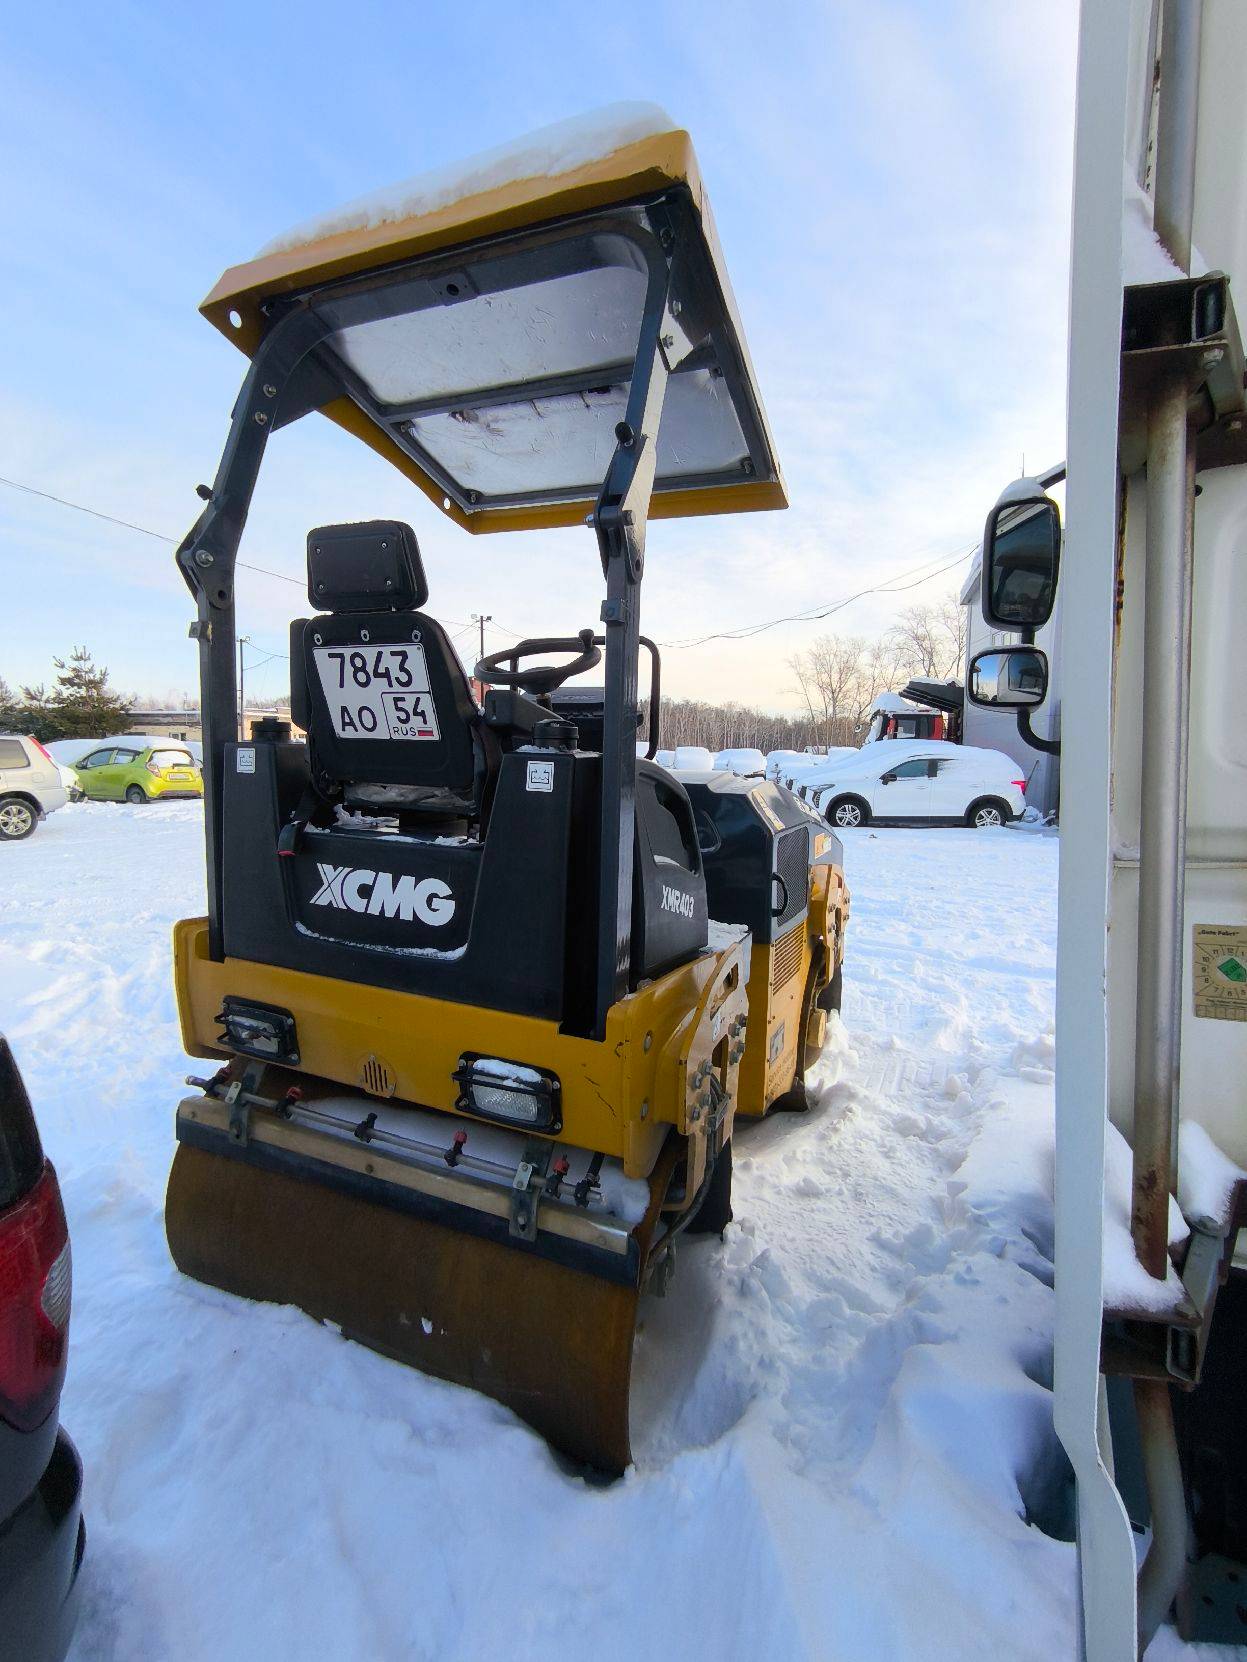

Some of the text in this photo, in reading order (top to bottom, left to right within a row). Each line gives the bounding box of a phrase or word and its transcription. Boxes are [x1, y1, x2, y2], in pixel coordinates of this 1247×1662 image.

[328, 650, 413, 689] 7843
[340, 705, 378, 732] AO
[392, 696, 428, 725] 54
[392, 726, 417, 736] RUS
[309, 862, 456, 927] XCMG
[660, 884, 695, 918] XMR403
